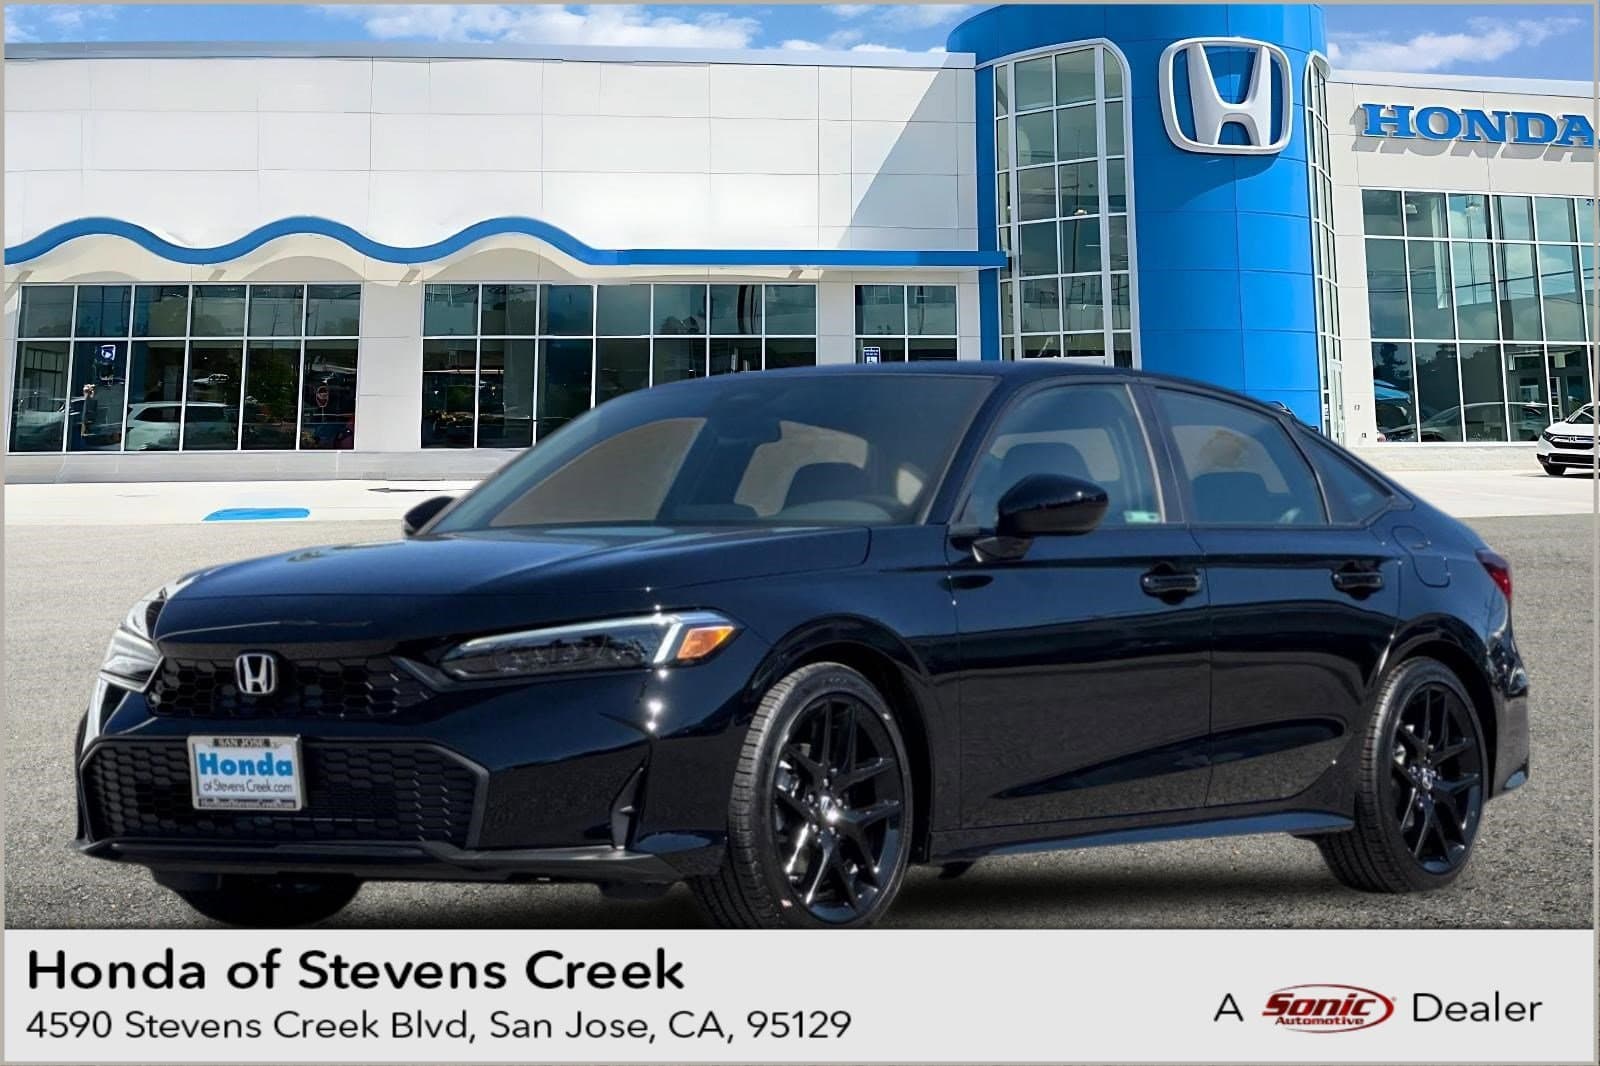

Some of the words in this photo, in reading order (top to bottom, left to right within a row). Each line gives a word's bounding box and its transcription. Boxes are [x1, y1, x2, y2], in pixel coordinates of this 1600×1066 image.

[1360, 103, 1595, 148] HONDA
[198, 752, 293, 776] Honda
[203, 780, 212, 792] of
[213, 779, 245, 792] Stevens
